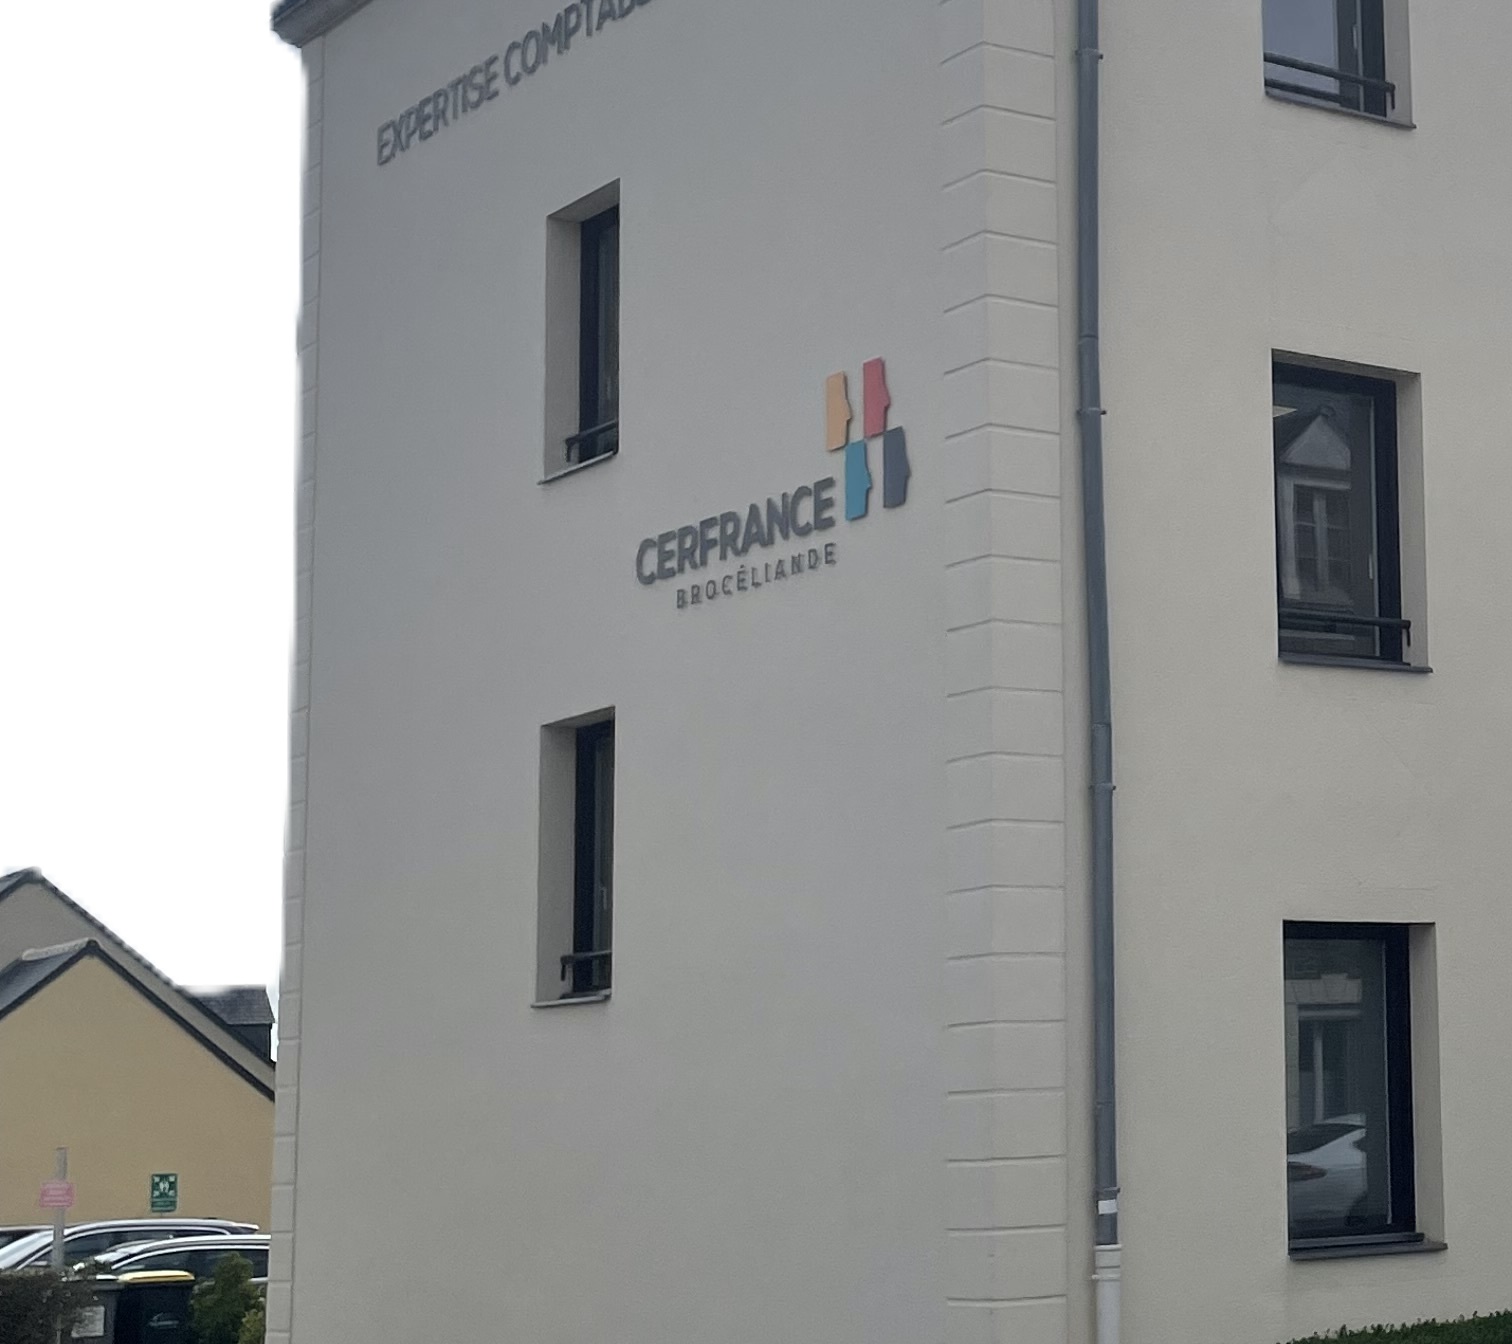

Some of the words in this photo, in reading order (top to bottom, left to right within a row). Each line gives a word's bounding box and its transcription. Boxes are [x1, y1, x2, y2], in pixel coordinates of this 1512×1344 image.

[377, 56, 500, 166] EXPERTISE
[636, 476, 836, 586] CERFRANCE
[676, 542, 837, 609] BROCÉLIANDE
